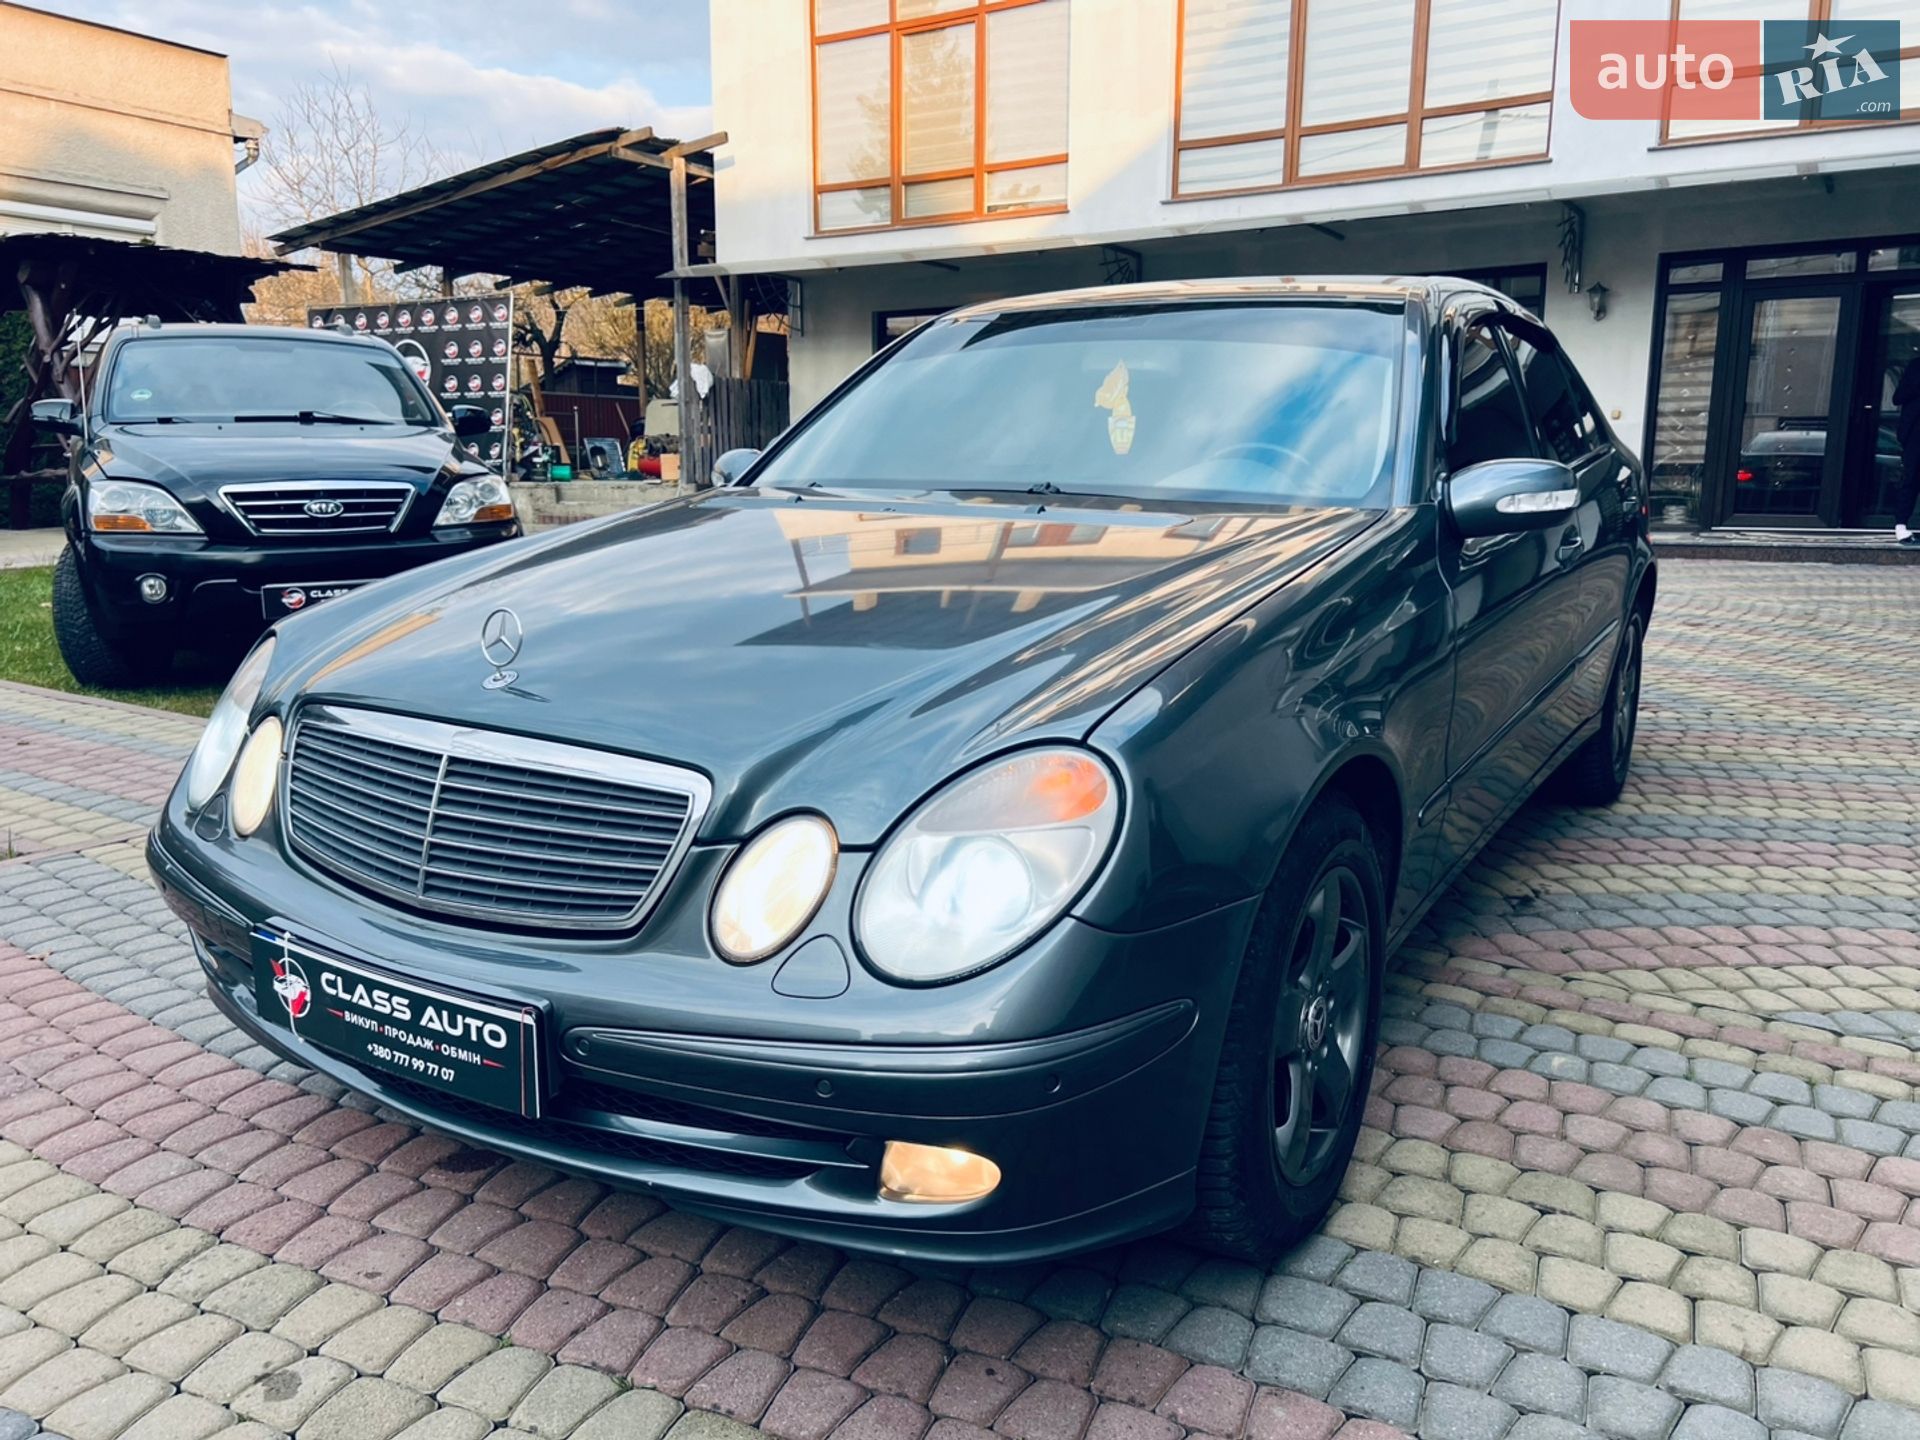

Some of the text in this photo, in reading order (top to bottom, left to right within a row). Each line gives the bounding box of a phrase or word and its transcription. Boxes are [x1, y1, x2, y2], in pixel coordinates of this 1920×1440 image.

[309, 502, 337, 514] KIA
[320, 972, 508, 1049] CLASS AUTO
[344, 1011, 482, 1066] ВИКУП ПРОДАЖ ОБМІН
[366, 1042, 455, 1083] +380 777 99 77 07
